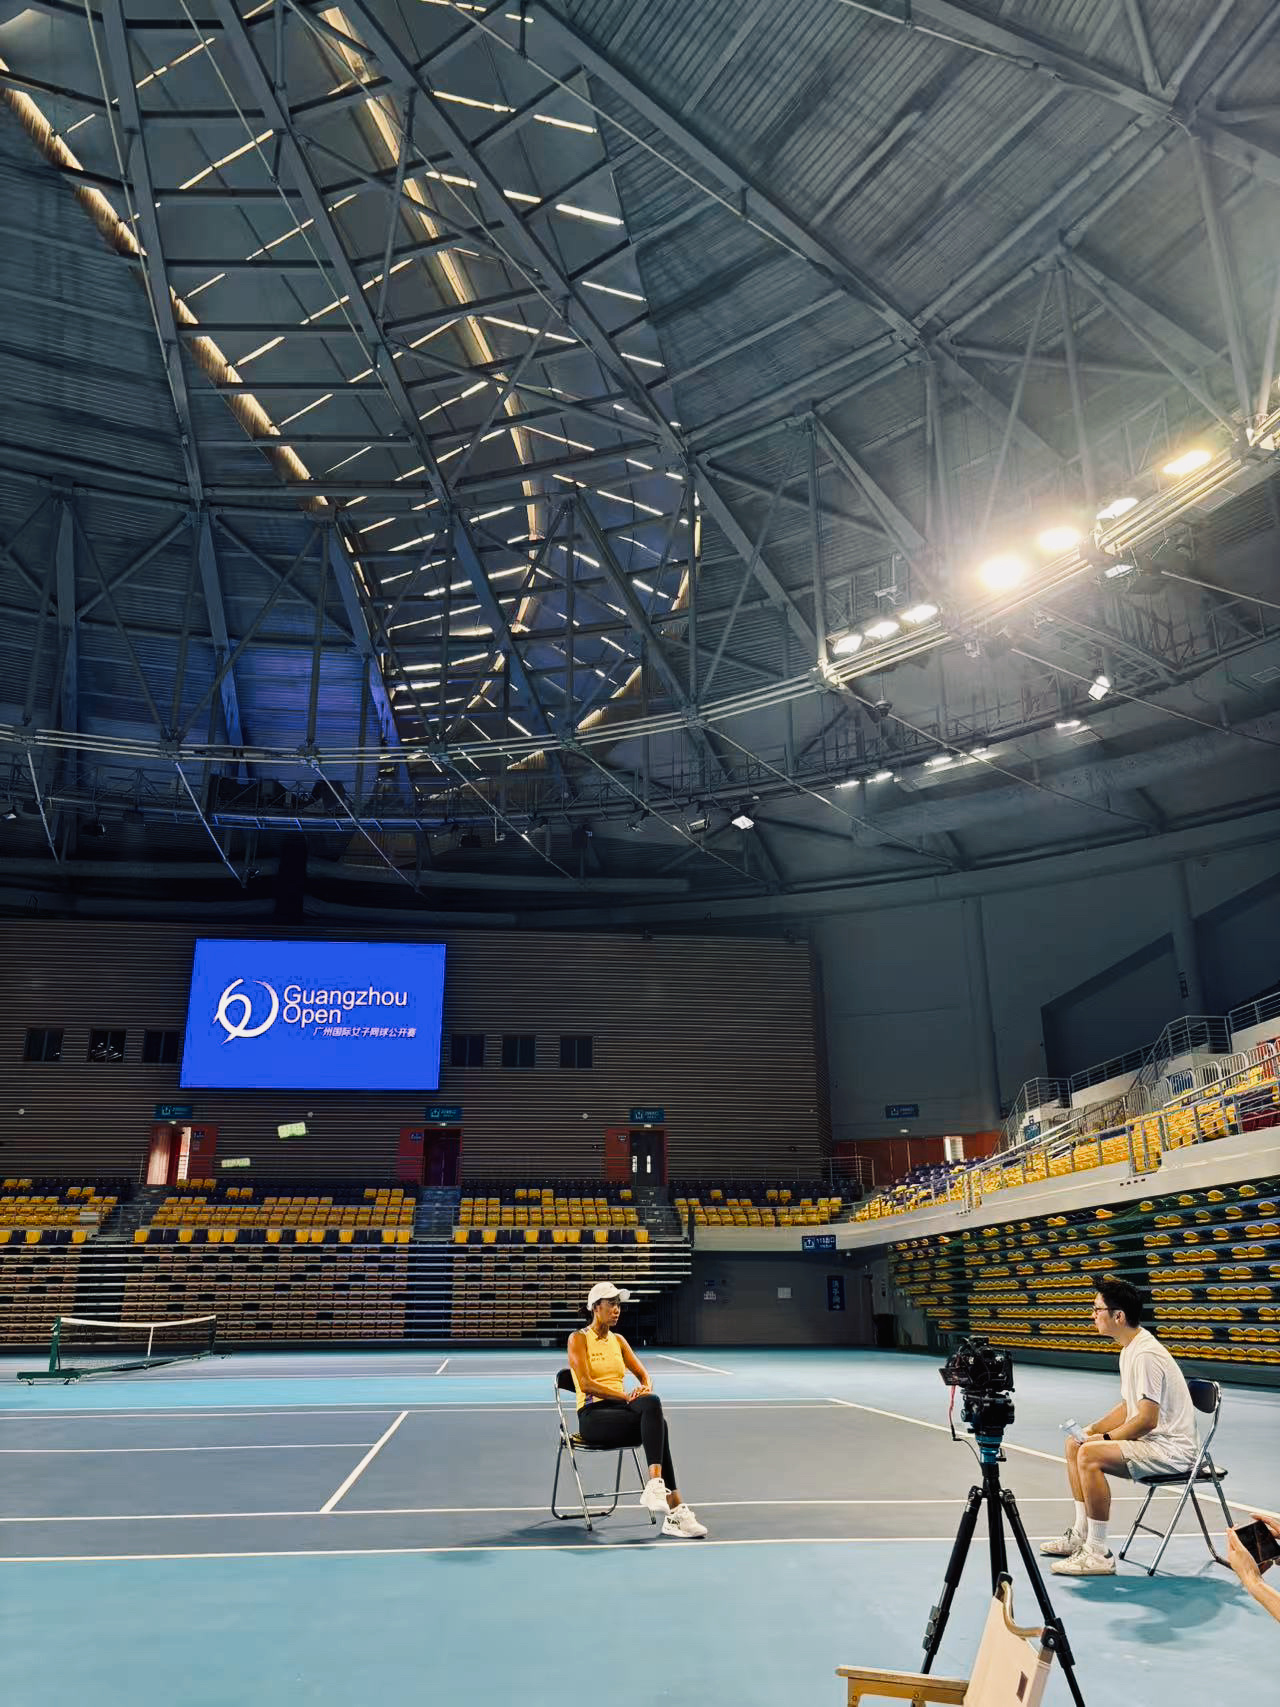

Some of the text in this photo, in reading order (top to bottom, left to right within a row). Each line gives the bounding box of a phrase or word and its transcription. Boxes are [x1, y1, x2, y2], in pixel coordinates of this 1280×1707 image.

[283, 984, 408, 1010] Guangzhou
[282, 1003, 341, 1028] Open
[313, 1026, 417, 1038] 广州国际女子网球公开赛
